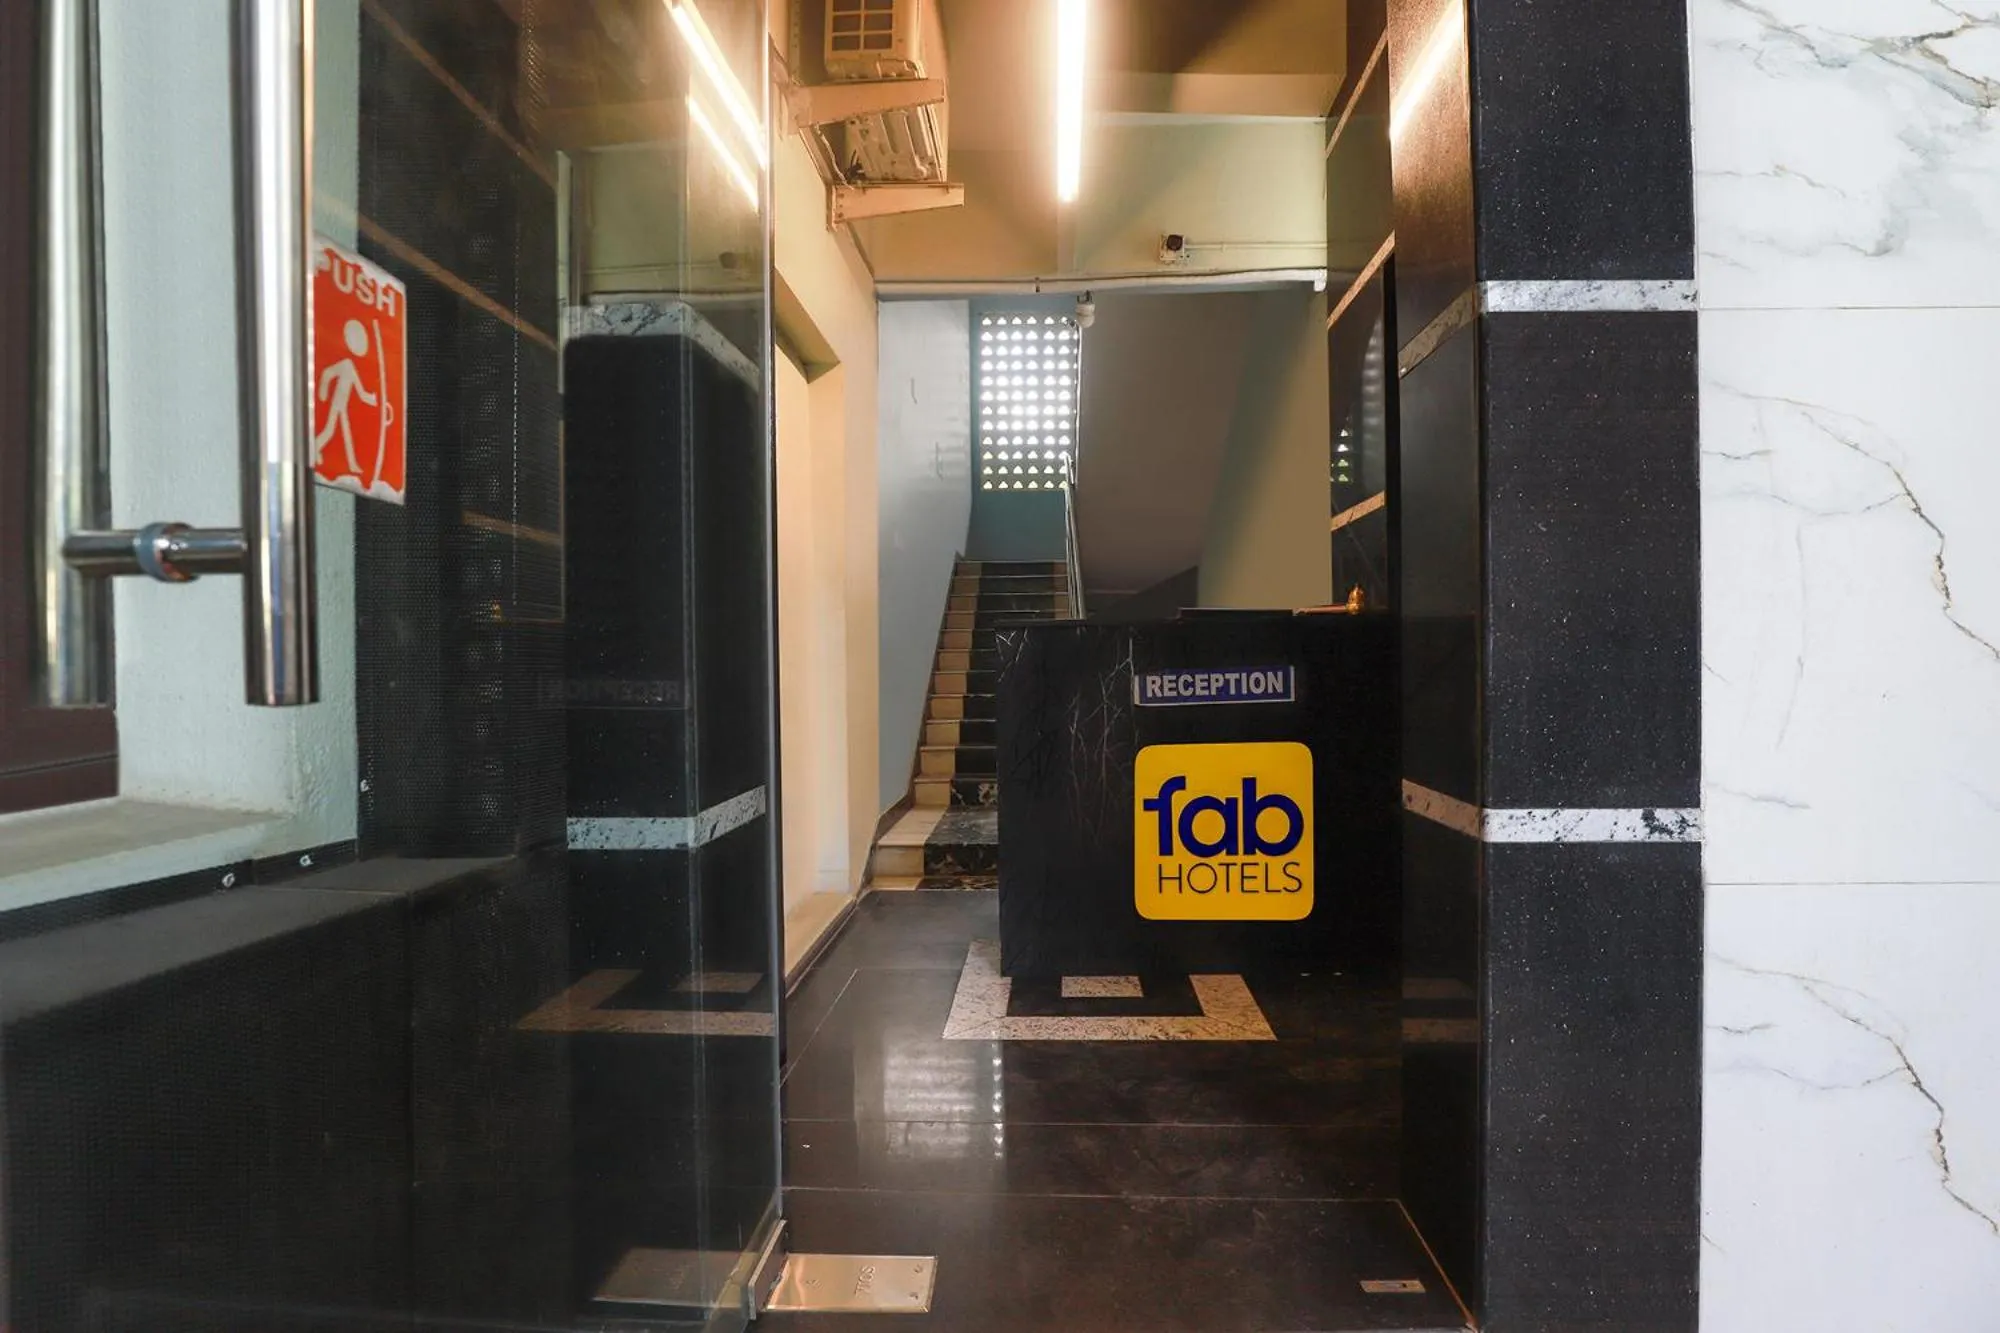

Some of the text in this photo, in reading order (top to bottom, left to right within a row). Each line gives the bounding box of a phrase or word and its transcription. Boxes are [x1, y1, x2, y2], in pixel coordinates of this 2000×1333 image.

[1146, 671, 1284, 698] RECEPTION
[1143, 775, 1305, 858] fab
[1158, 861, 1303, 895] HOTELS
